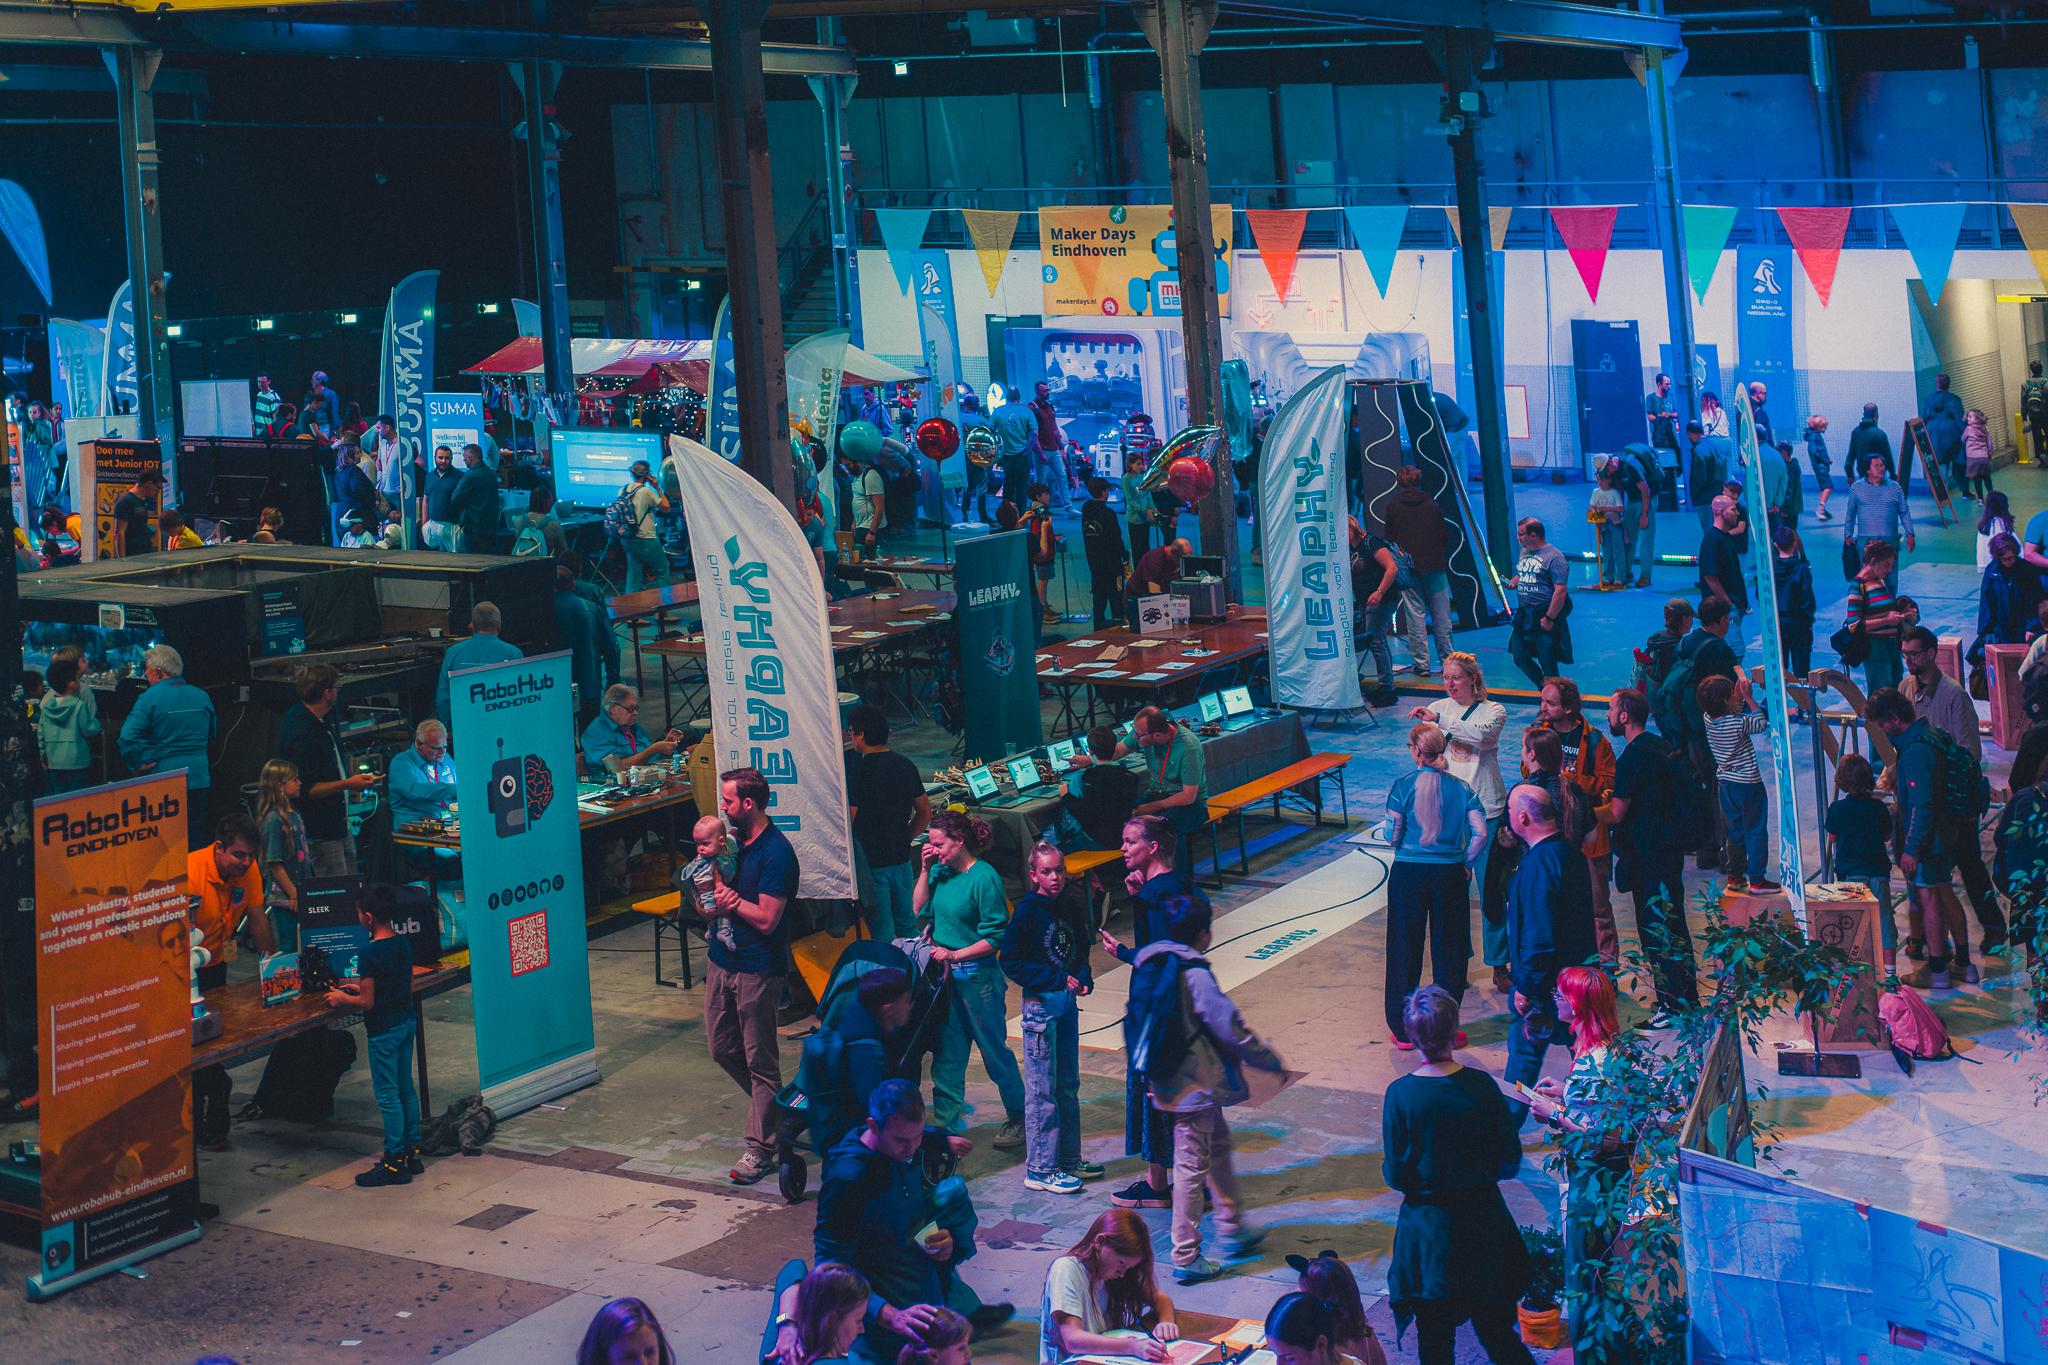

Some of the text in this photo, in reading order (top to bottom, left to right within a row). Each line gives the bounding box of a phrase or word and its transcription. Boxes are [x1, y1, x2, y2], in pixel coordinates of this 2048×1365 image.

[1050, 227, 1136, 244] Maker Days
[1052, 243, 1127, 257] Eindhoven
[1056, 297, 1097, 306] makerdays.nl
[429, 401, 478, 416] SUMMA
[816, 367, 833, 445] alenta
[96, 445, 134, 456] Doe mee
[436, 433, 457, 441] Welkom
[96, 459, 113, 468] met
[114, 458, 143, 469] Junior
[1292, 453, 1340, 662] LEAPHY
[968, 582, 1019, 606] LEAPHY
[469, 673, 554, 704] RoboHub
[485, 693, 541, 712] EINDHOVEN
[42, 794, 180, 846] RoboHub
[66, 825, 159, 857] EINDHOVEN
[39, 894, 187, 941] and young professionals work
[50, 884, 176, 923] Where industry, students
[308, 905, 330, 914] SLEEK
[43, 908, 187, 954] together on robotic solutions
[1244, 928, 1318, 960] LEAPHY
[56, 976, 160, 1012] Competing in RoboCup@Work
[56, 1001, 140, 1032] Researching automation
[56, 1023, 136, 1052] Sharing our knowledge
[56, 1028, 186, 1072] Helping companies within automation
[57, 1058, 149, 1093] Inspire the new generation
[50, 1165, 188, 1222] www.robohub-eindhoven.nl
